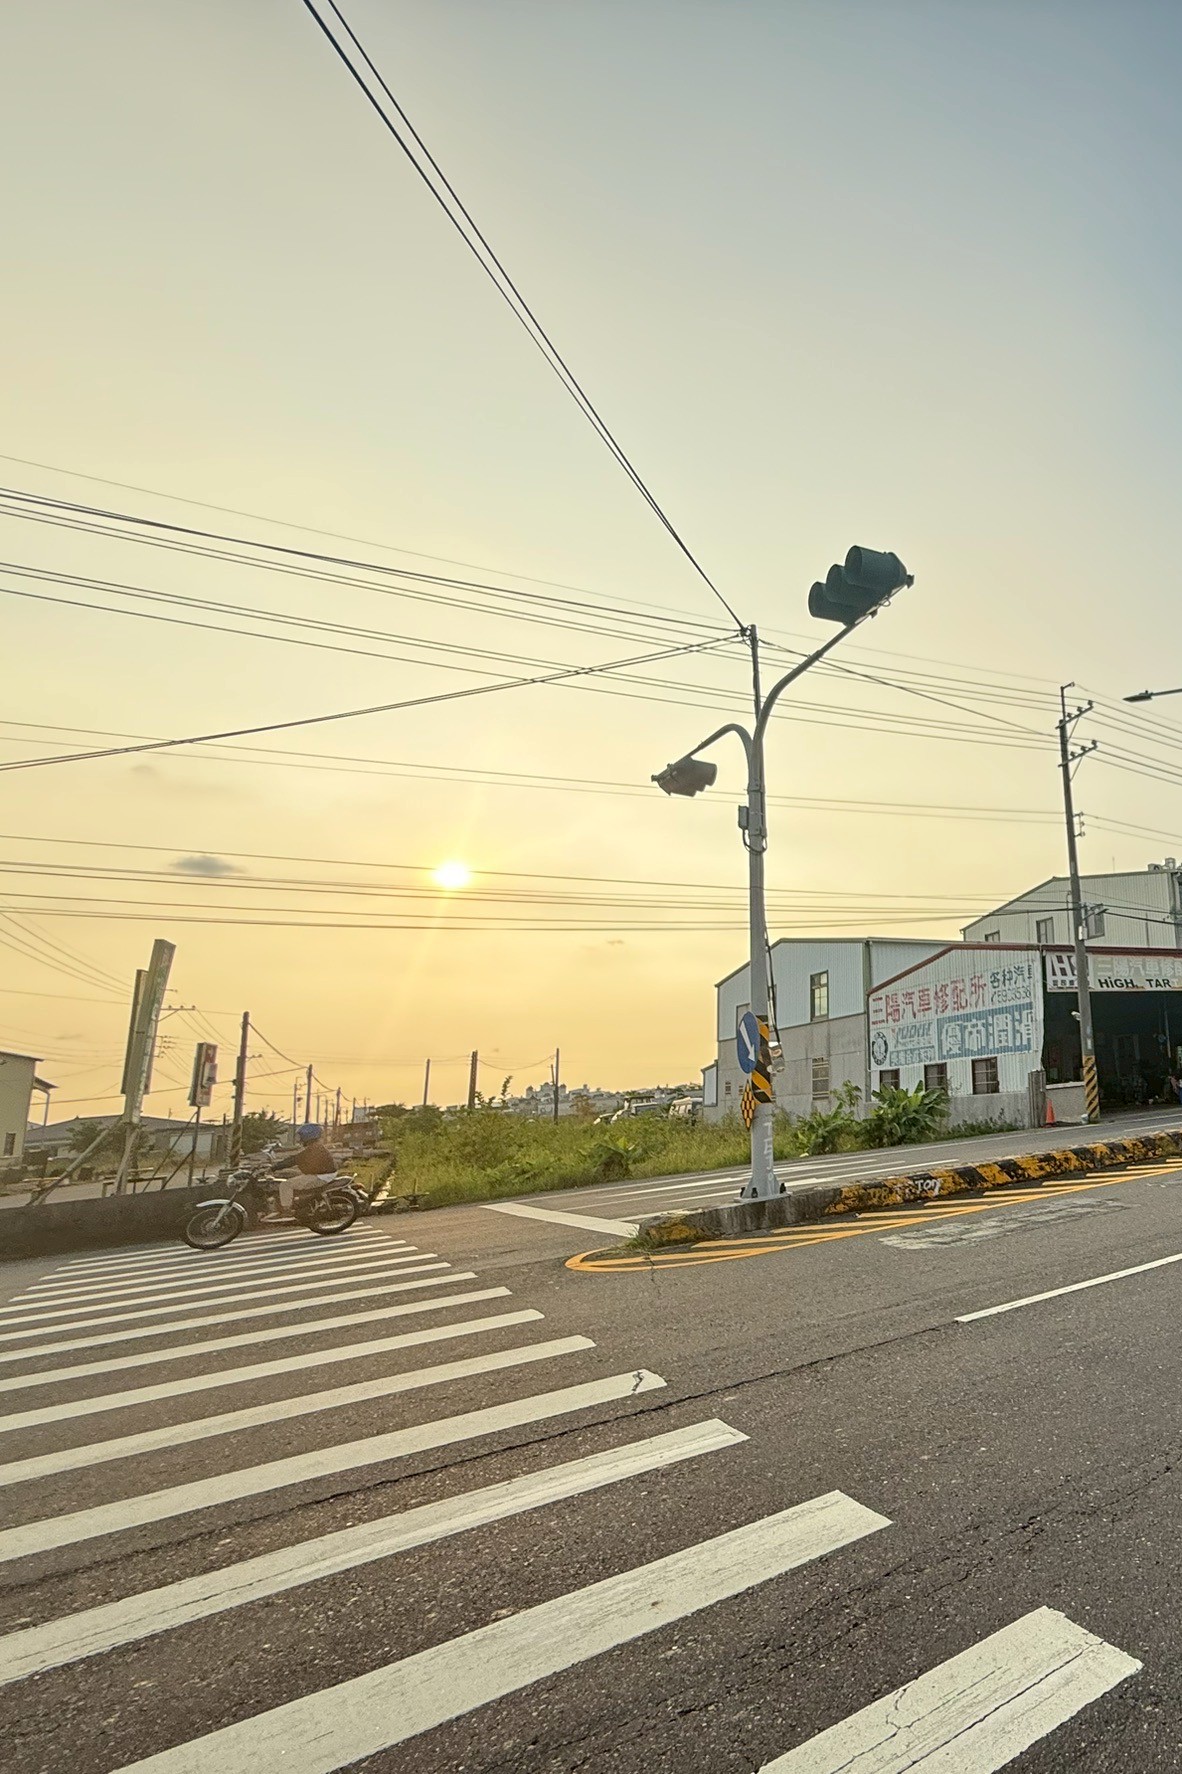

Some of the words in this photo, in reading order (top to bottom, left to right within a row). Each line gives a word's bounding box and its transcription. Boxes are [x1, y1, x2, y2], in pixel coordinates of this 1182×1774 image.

[872, 974, 987, 1025] 三陽汽車修配所
